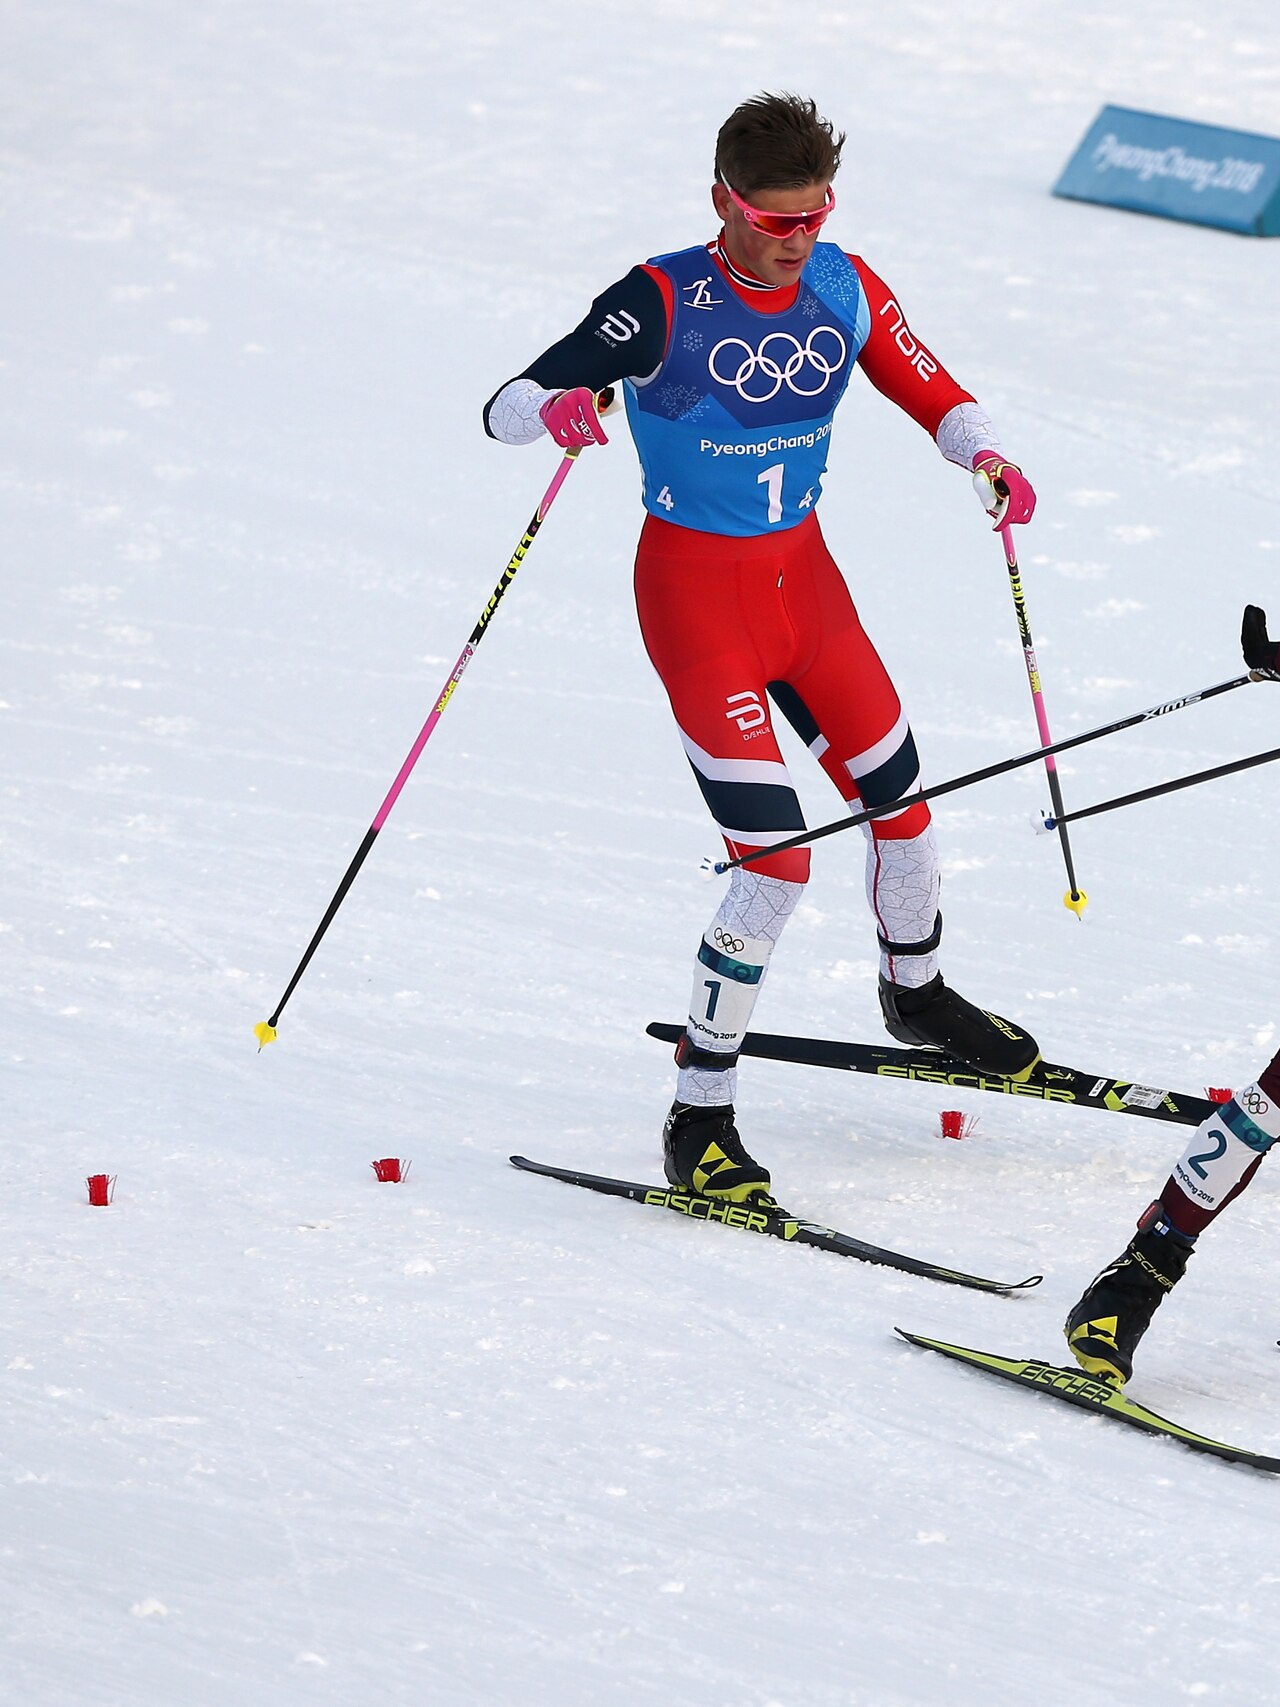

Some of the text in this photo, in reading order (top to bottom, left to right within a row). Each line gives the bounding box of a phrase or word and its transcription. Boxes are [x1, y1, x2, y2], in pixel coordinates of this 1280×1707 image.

[1092, 134, 1217, 192] PyeongChang
[700, 432, 814, 457] PyeongChang
[656, 485, 675, 511] 4
[757, 463, 785, 524] 1
[704, 980, 721, 1022] 1
[877, 1064, 1076, 1104] FISCHER
[1188, 1130, 1227, 1180] 2
[644, 1190, 769, 1233] FISCHER
[1130, 1241, 1175, 1289] FSCHER
[1018, 1366, 1113, 1404] FISCHER
